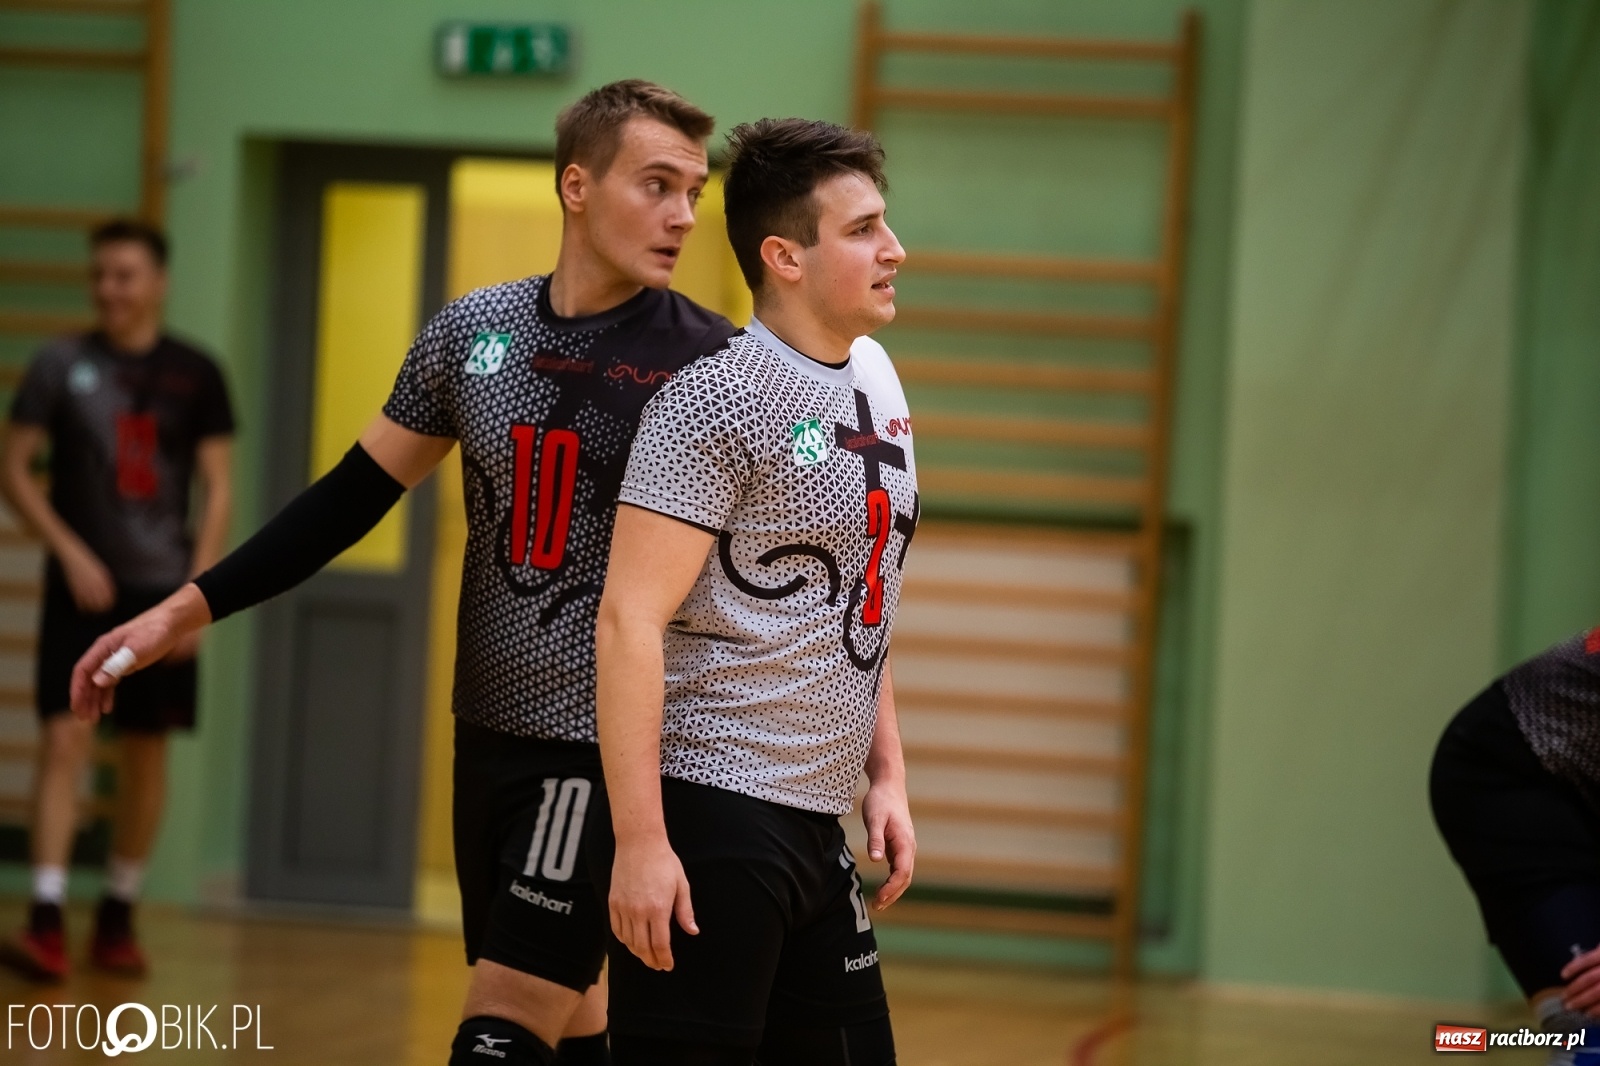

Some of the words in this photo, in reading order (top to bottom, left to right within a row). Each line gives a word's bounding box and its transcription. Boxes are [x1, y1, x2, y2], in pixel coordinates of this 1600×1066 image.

[510, 424, 580, 570] 10
[862, 489, 891, 626] 2
[522, 777, 592, 882] 10
[509, 879, 573, 915] kalahari
